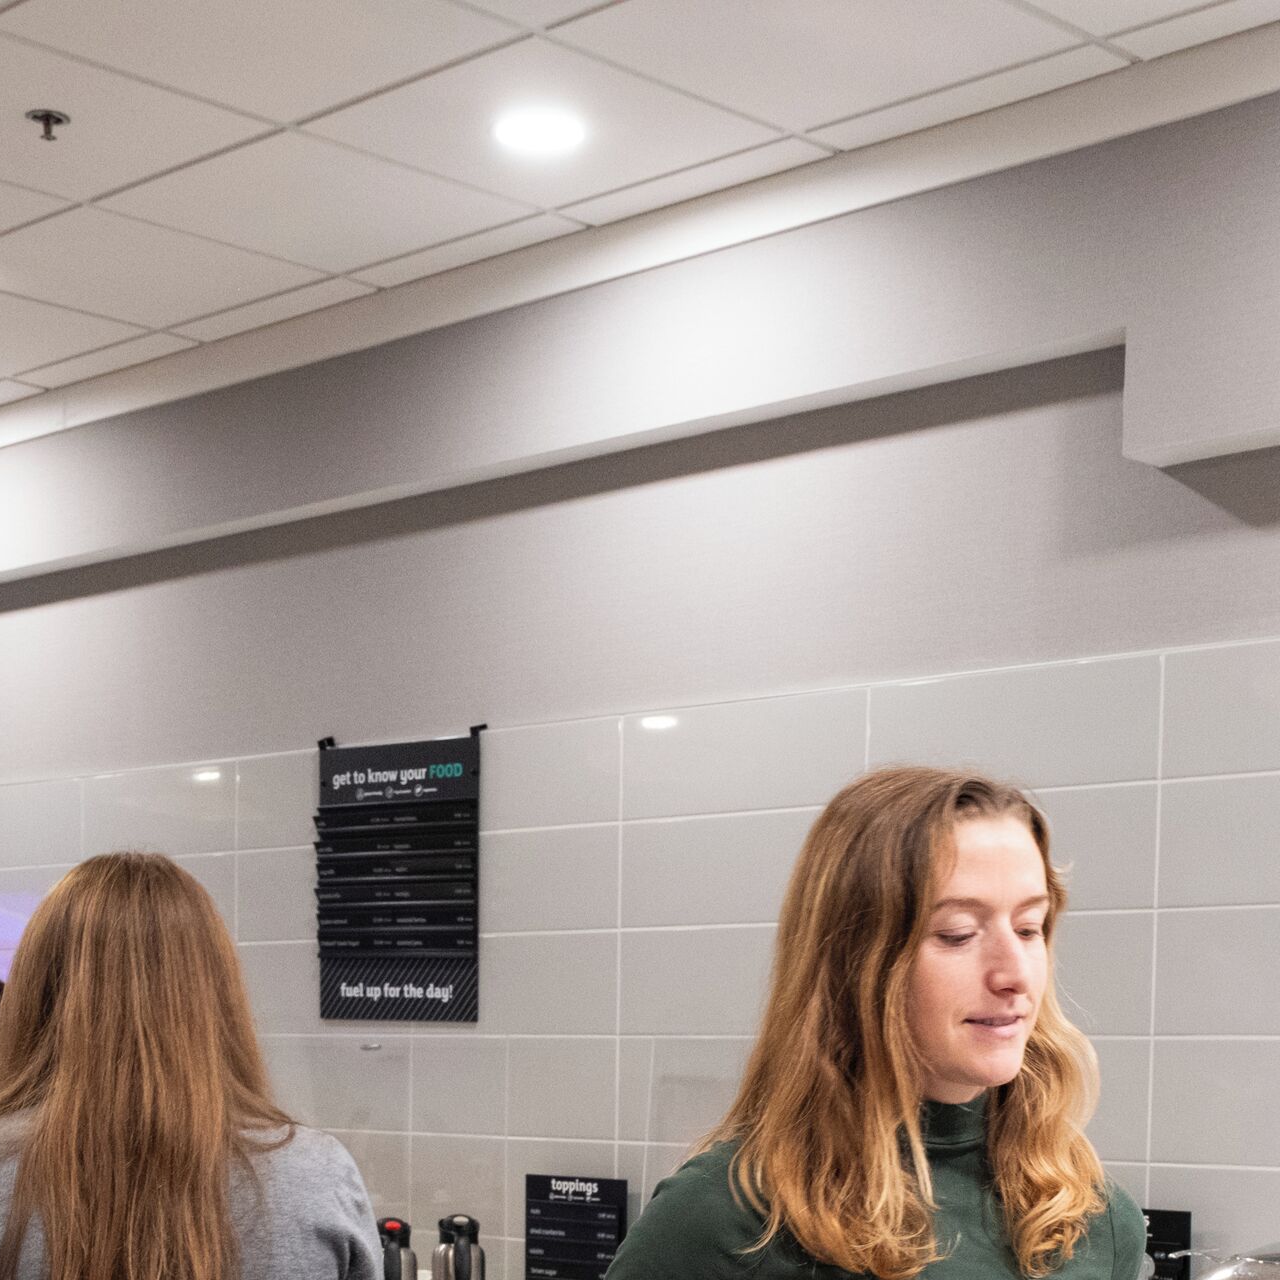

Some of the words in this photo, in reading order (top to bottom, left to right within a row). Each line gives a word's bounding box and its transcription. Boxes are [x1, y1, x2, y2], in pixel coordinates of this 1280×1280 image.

[332, 771, 351, 790] get
[353, 770, 366, 785] to
[367, 768, 398, 783] know
[400, 768, 427, 785] your
[429, 763, 463, 779] FOOD
[340, 982, 364, 997] fuel
[366, 986, 381, 1001] up
[383, 982, 401, 998] for
[403, 983, 424, 999] the
[425, 984, 453, 1003] day!
[551, 1178, 599, 1196] toppings
